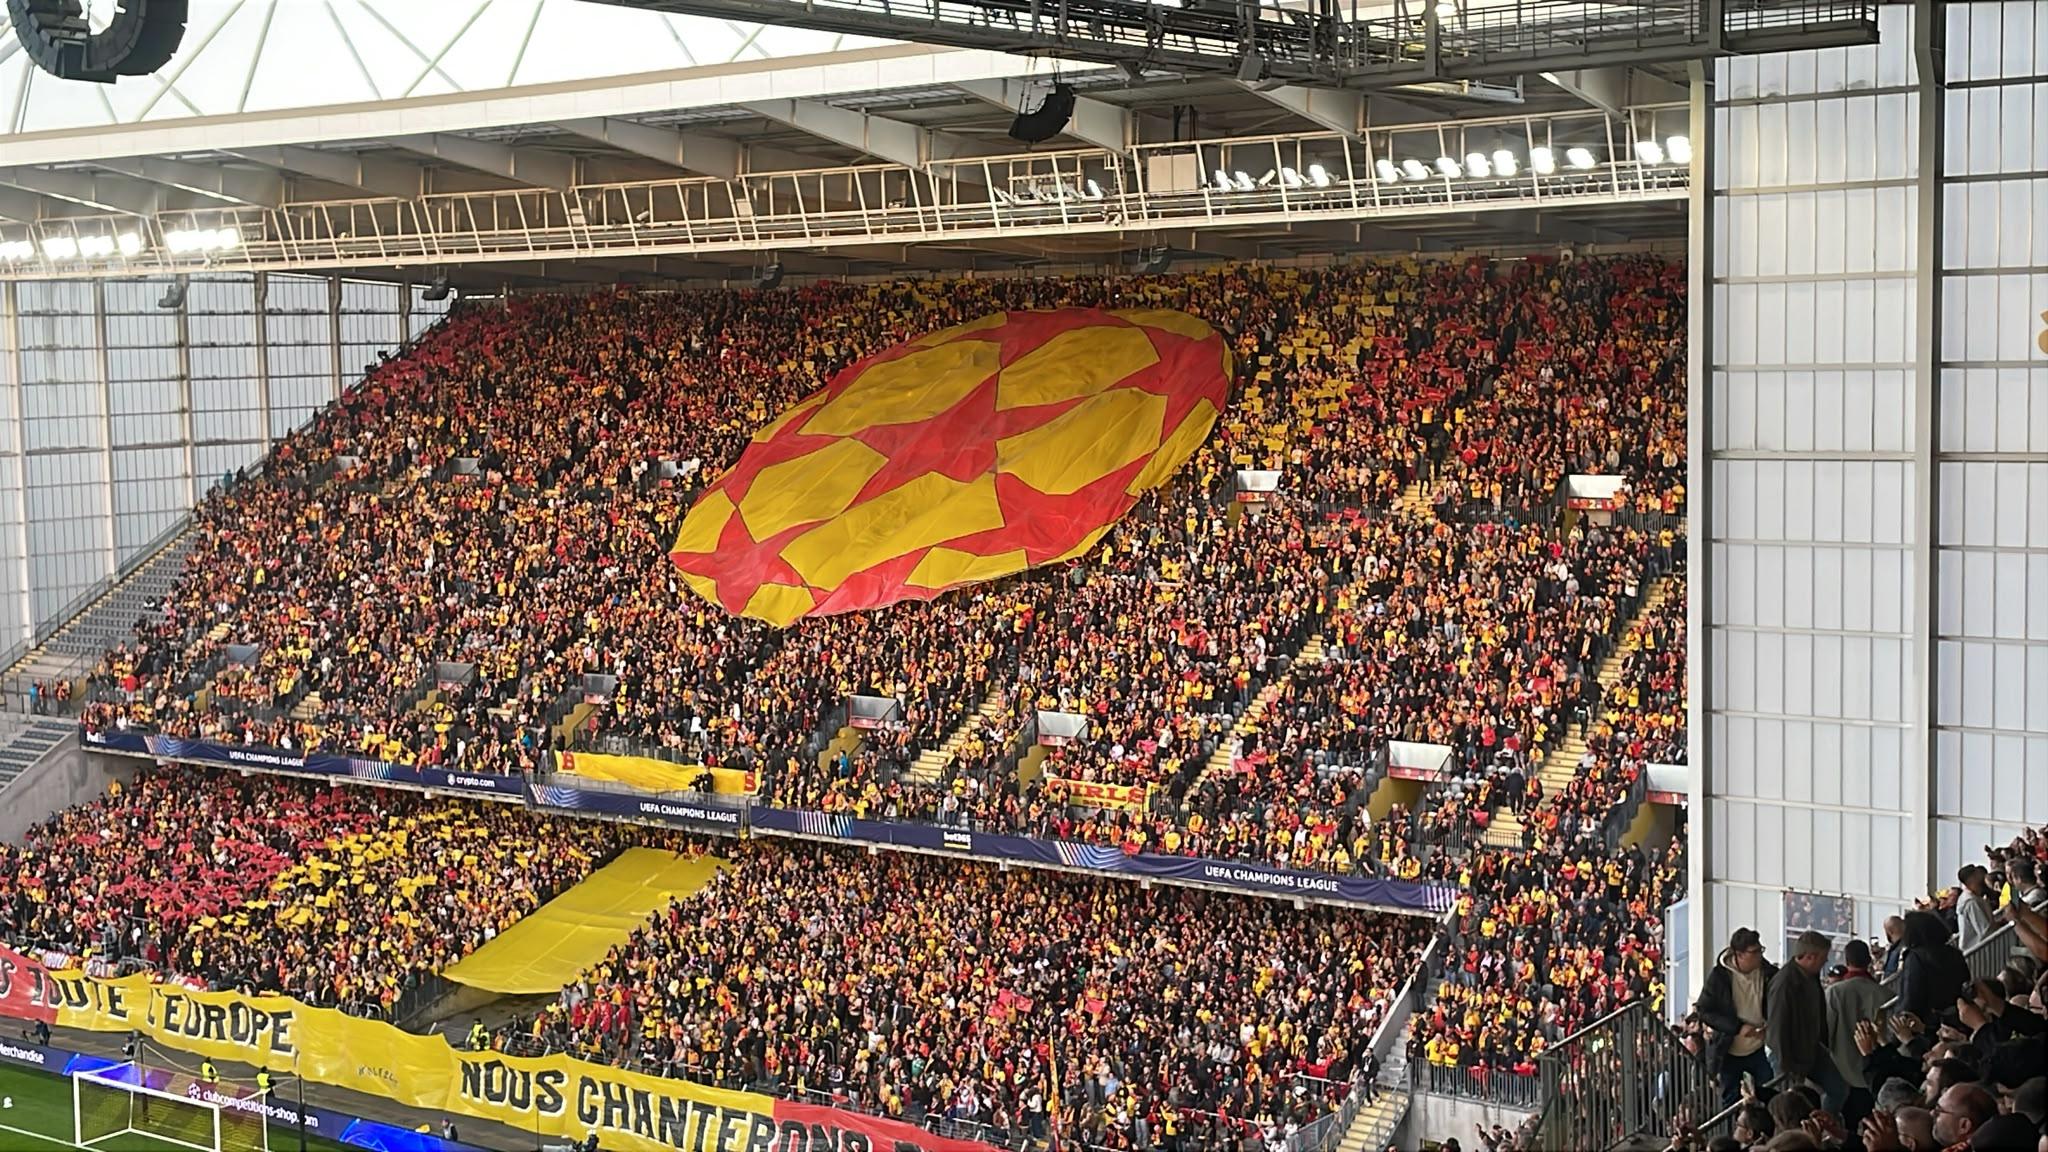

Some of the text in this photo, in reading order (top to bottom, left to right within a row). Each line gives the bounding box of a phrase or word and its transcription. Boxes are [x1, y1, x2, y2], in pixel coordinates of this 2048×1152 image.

[229, 751, 304, 767] UEFA CHAMPIONS LEAGUE
[456, 776, 496, 788] crypto.com
[640, 802, 738, 823] UEFA CHAMPIONS LEAGUE
[1204, 865, 1338, 892] UEFA CHAMPIONS LEAGUE
[26, 965, 129, 1022] TOUTE
[0, 1043, 45, 1064] erchandise
[457, 1058, 567, 1117] NOUS
